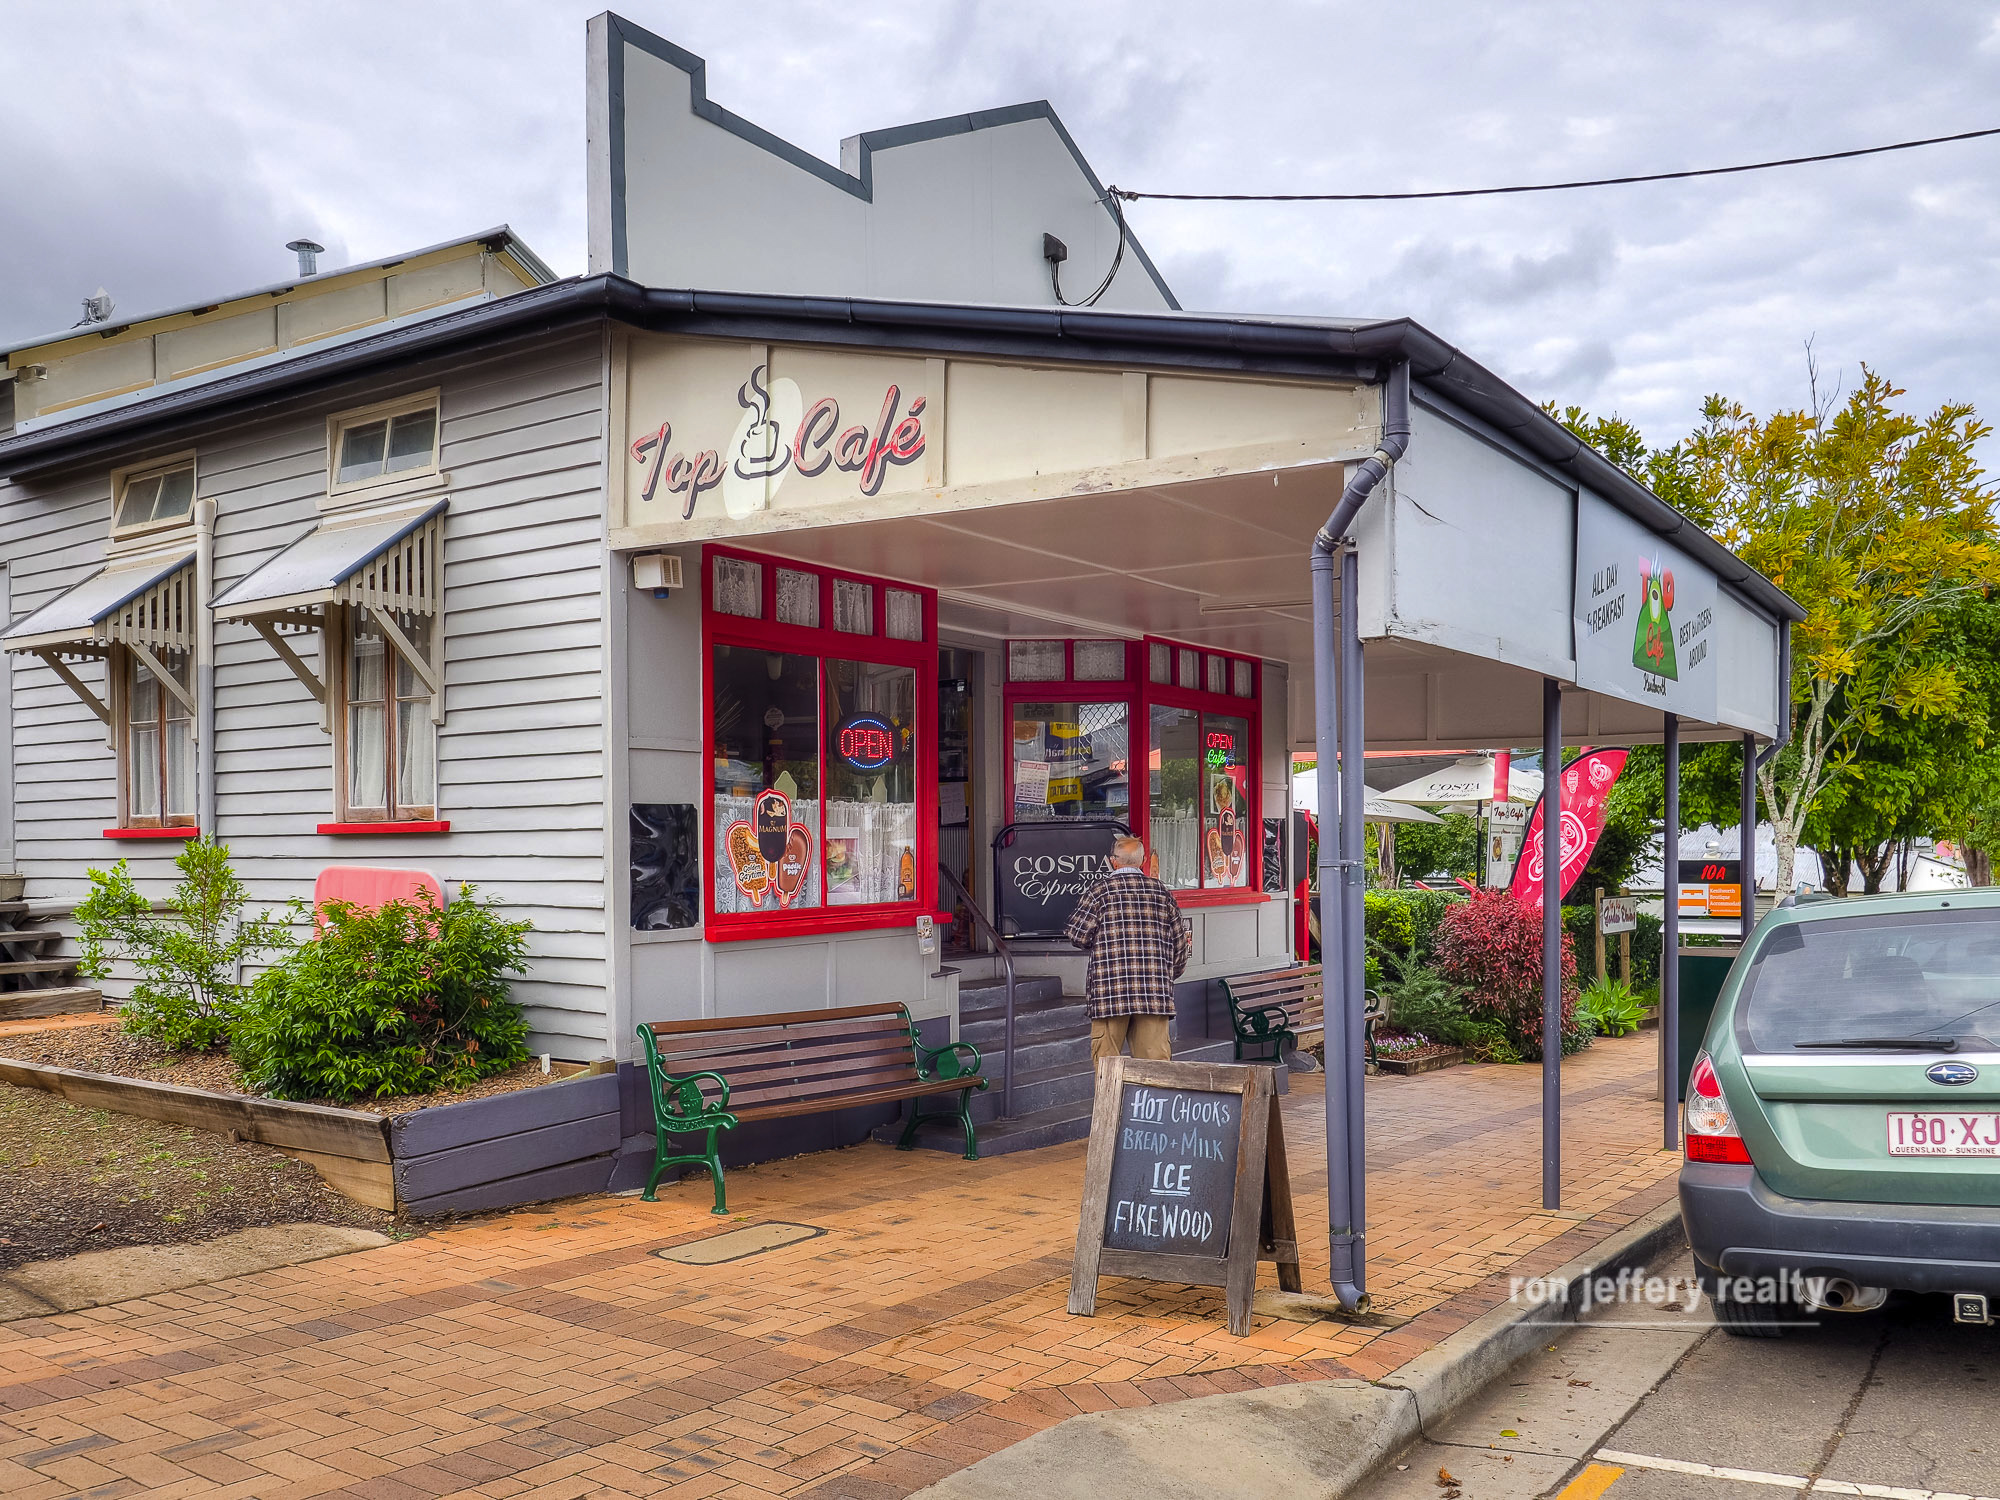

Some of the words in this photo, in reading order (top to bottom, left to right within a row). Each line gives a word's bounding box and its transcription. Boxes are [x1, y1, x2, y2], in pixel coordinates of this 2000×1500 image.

[630, 421, 728, 520] Top
[793, 384, 926, 496] Café
[1592, 570, 1604, 598] ALL
[1606, 562, 1618, 590] DAY
[1679, 621, 1691, 647] BEST
[1689, 639, 1706, 671] AROUND
[840, 729, 893, 759] OPEN
[1207, 732, 1233, 749] OPEN
[759, 825, 787, 833] MAGNUM
[1014, 855, 1114, 875] COSTA
[1701, 864, 1726, 880] 10A
[1014, 872, 1095, 905] Espres
[1130, 1089, 1168, 1121] HOT
[1171, 1094, 1231, 1127] CHOOKS
[1122, 1128, 1168, 1155] BREAD
[1181, 1127, 1225, 1162] MILK
[1152, 1161, 1192, 1191] ICE
[1114, 1200, 1213, 1243] FIREWOOD
